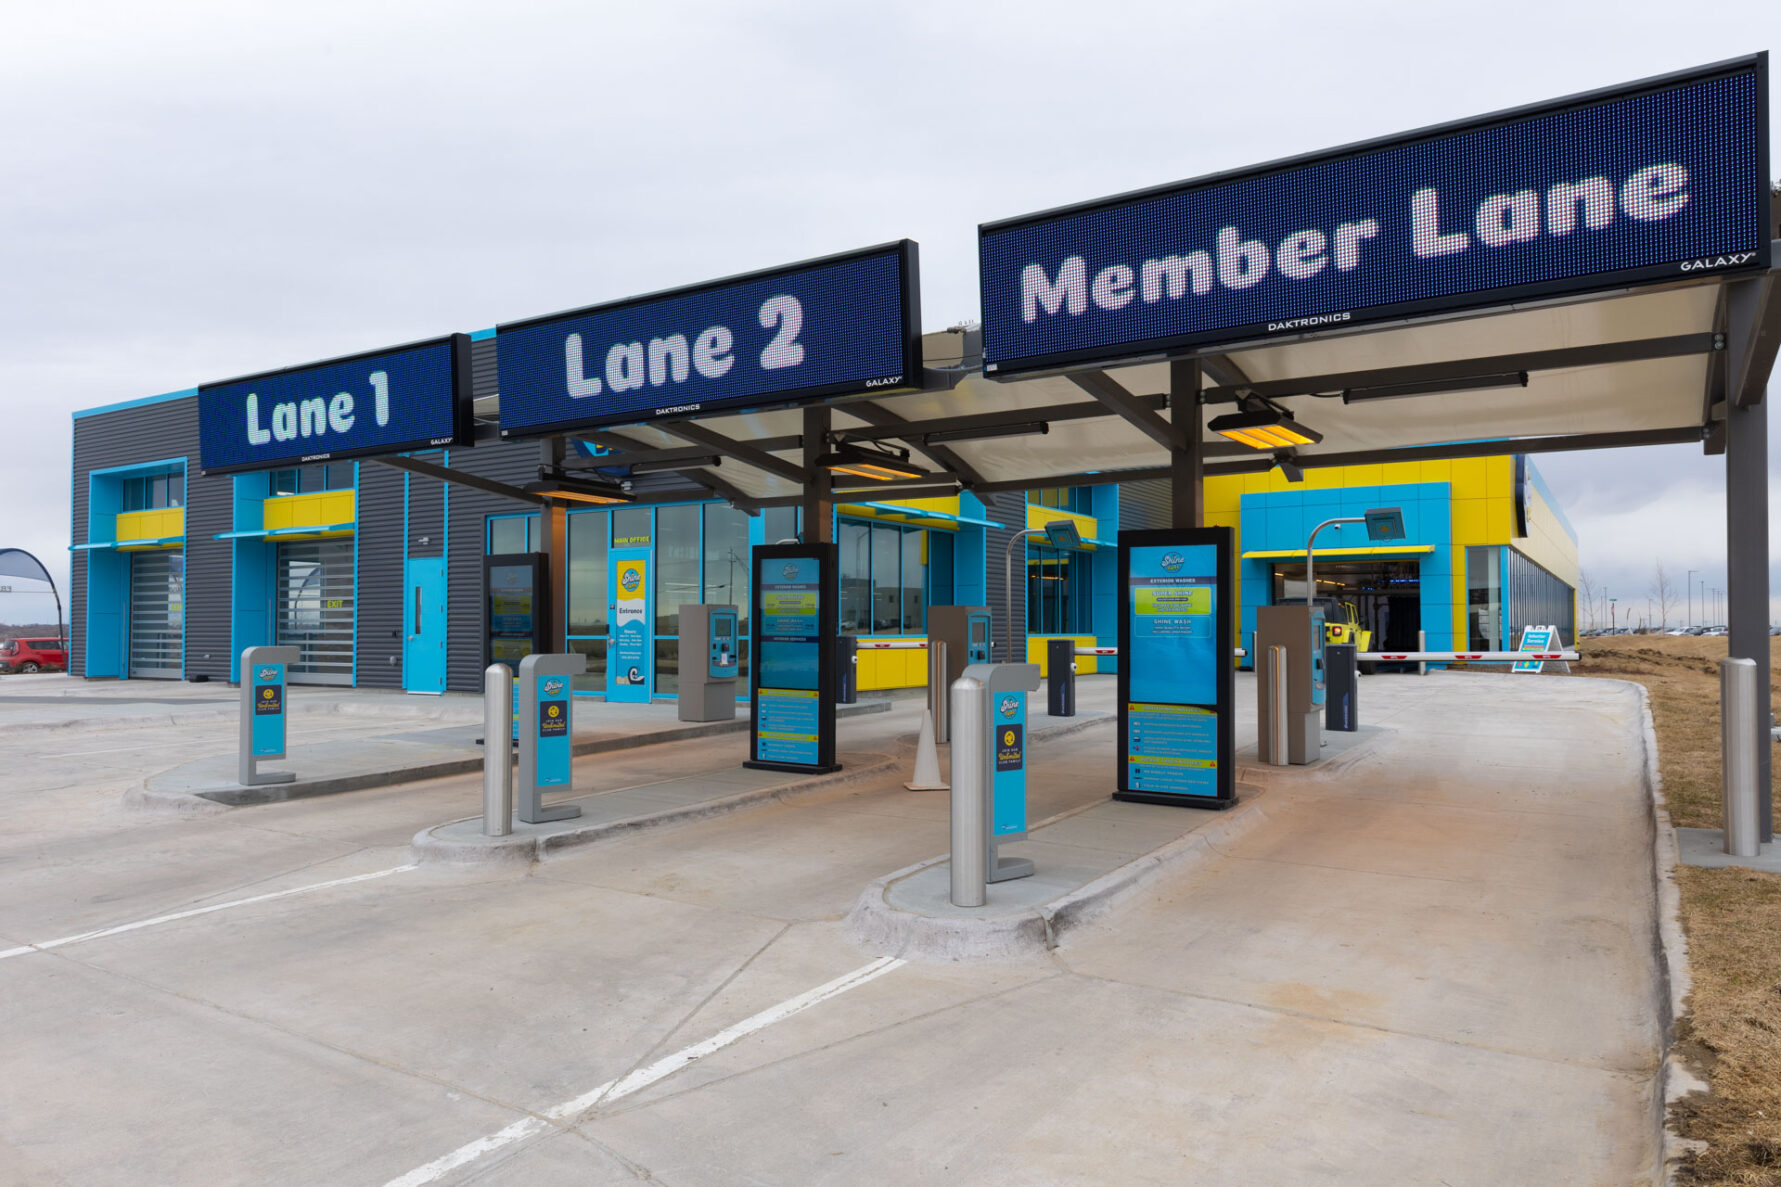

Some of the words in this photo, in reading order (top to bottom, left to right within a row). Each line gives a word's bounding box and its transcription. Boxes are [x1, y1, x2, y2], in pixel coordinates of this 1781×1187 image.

[1020, 218, 1381, 324] Member
[1411, 162, 1690, 259] Lane
[1680, 252, 1756, 272] GALAXY
[1268, 312, 1351, 332] DAKTRONICS
[565, 325, 735, 399] Lane
[758, 294, 805, 370] 2
[865, 376, 902, 388] GALAXY
[246, 391, 355, 445] Lane
[368, 370, 390, 427] 1
[655, 403, 700, 415] DAKTRONICS
[430, 437, 453, 445] GALAXY
[301, 453, 330, 461] DAKTRONICS
[1161, 555, 1185, 567] Shine
[622, 571, 640, 584] Shine
[327, 600, 343, 608] EXIT
[544, 681, 563, 691] Shine
[1000, 699, 1019, 713] Shine
